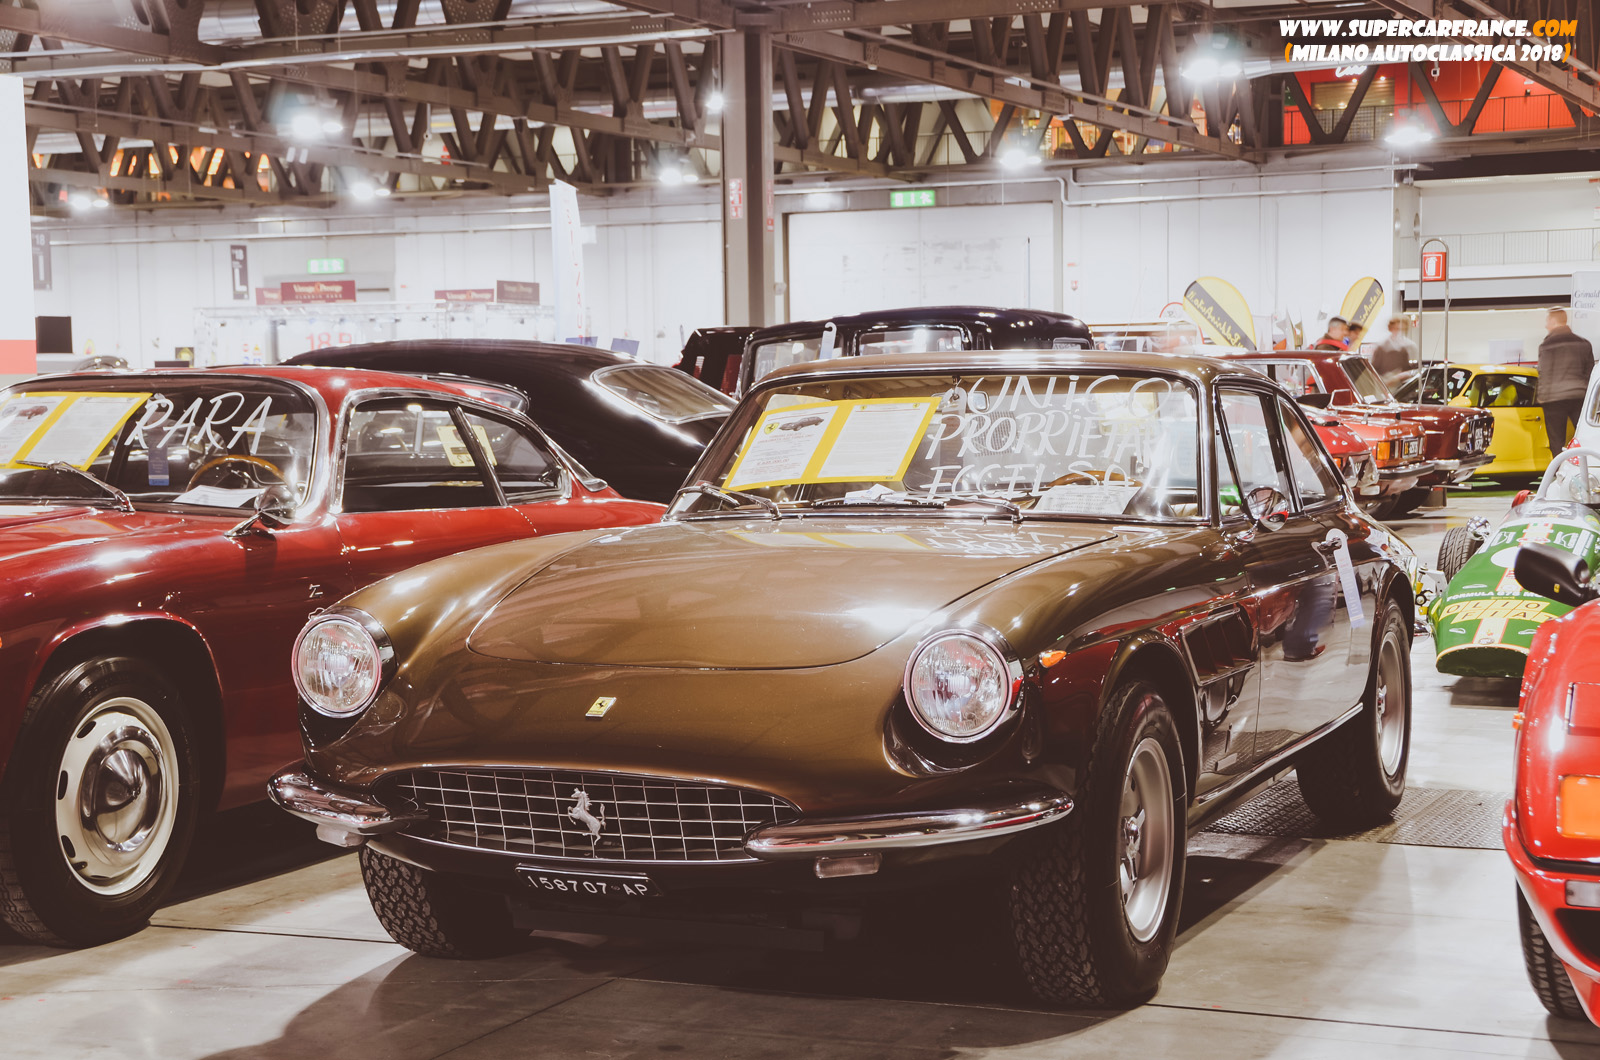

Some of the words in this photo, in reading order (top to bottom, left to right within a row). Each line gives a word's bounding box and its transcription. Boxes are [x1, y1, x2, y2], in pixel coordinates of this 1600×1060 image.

[1574, 290, 1600, 299] Grimald
[305, 332, 332, 351] 18
[124, 391, 273, 455] RARA
[1446, 591, 1495, 602] FORMULA
[1446, 601, 1541, 614] OLIO
[527, 875, 607, 895] 158707
[622, 882, 649, 896] AP
